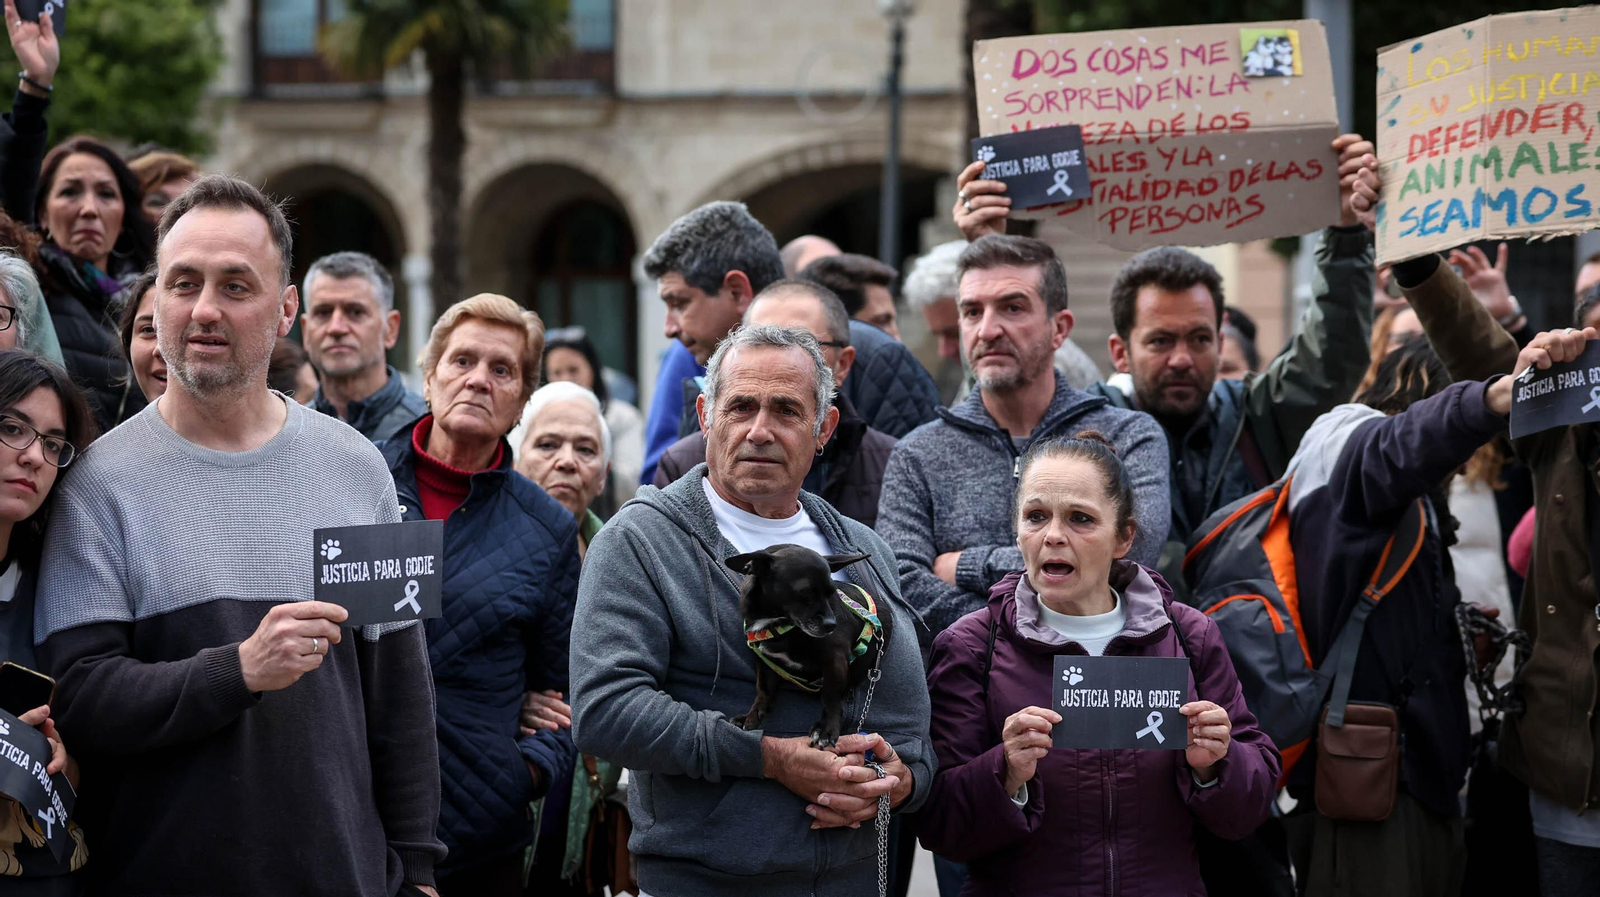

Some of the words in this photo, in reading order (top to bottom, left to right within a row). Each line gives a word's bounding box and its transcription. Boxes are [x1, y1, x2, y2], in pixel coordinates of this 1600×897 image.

[1012, 48, 1077, 80] DOS
[1087, 46, 1168, 76] COSAS
[1181, 41, 1229, 68] ME
[1407, 49, 1473, 88] LOS
[1406, 94, 1449, 126] SU
[1148, 113, 1185, 144] DE
[1196, 111, 1250, 134] LOS
[1406, 101, 1594, 164] DEFENDER,
[1022, 155, 1051, 174] PARA
[1098, 194, 1266, 234] PERSONAS
[1516, 376, 1556, 403] JUSTICIA
[1558, 370, 1586, 390] PARA
[320, 561, 371, 585] JUSTICIA
[374, 558, 402, 580] PARA
[1061, 689, 1109, 708] JUSTICIA
[1114, 689, 1144, 708] PARA
[0, 738, 30, 770] TICIA
[32, 761, 53, 796] PARA
